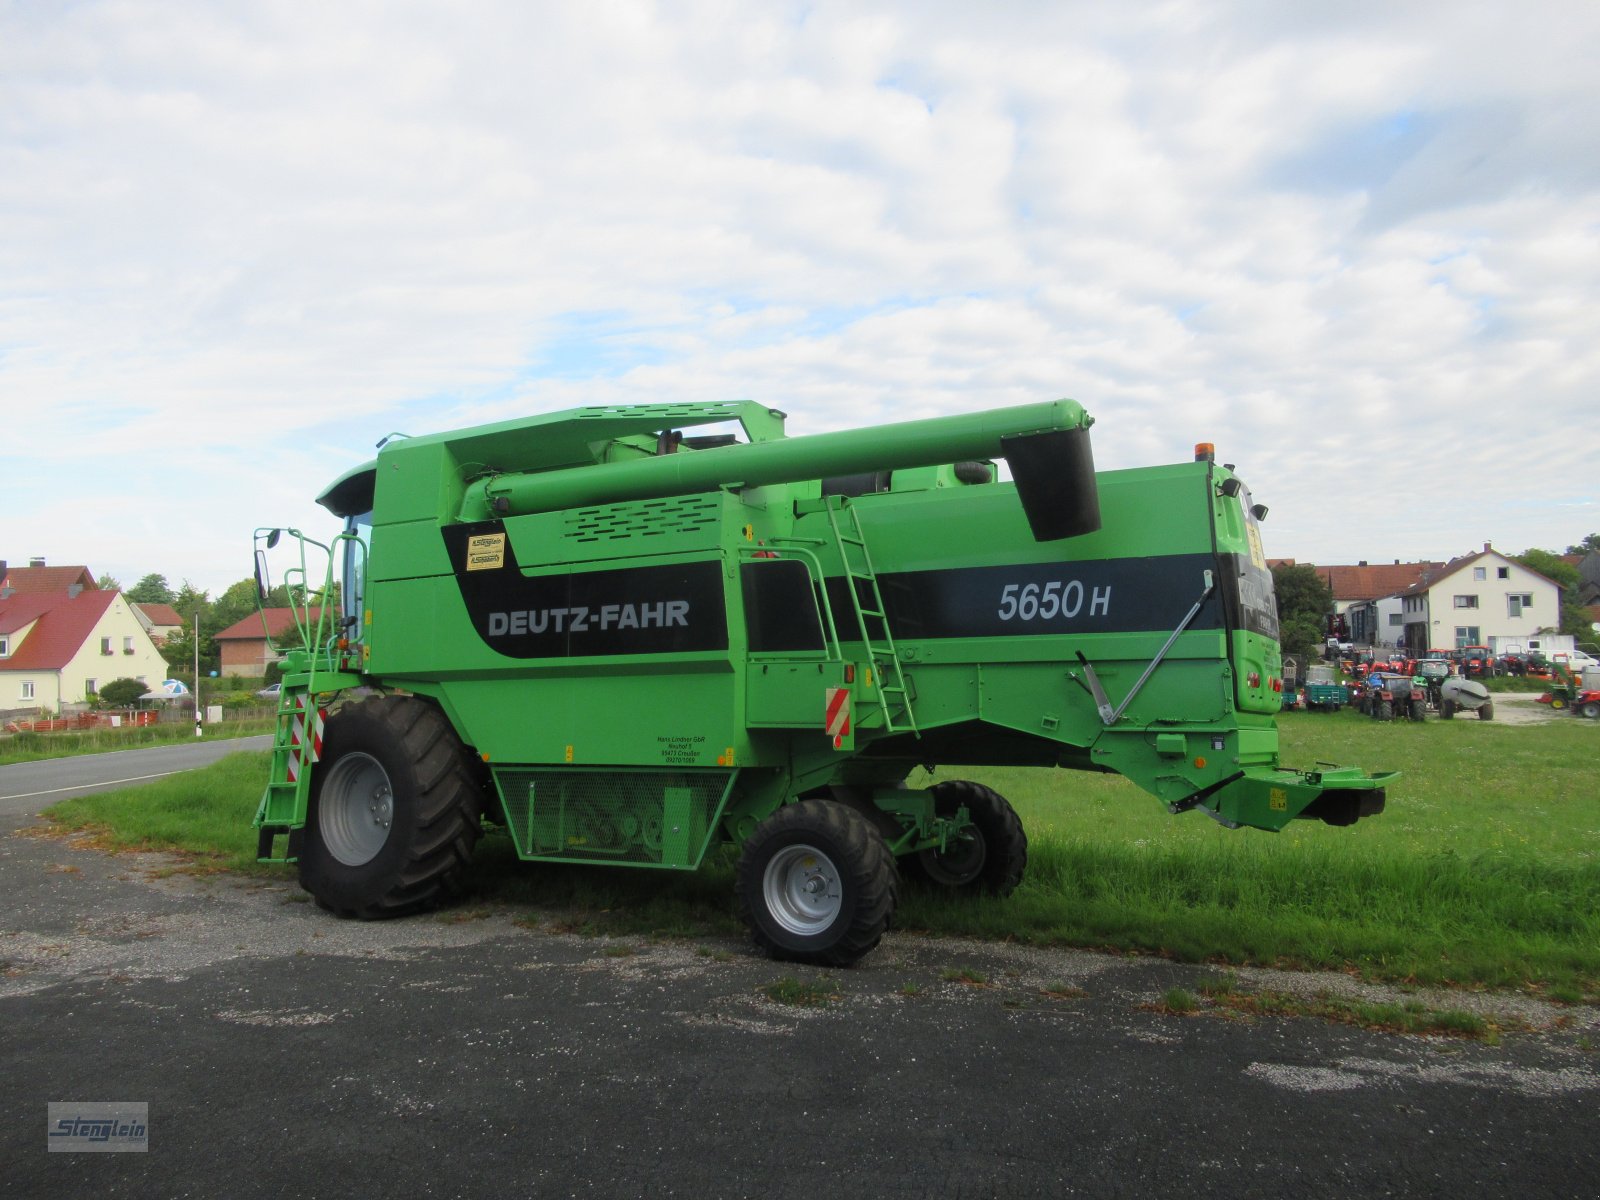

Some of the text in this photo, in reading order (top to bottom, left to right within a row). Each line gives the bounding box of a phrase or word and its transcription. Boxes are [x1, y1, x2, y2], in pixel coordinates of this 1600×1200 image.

[488, 600, 690, 637] DEUTZ-FAHR
[998, 580, 1112, 621] 5650 H
